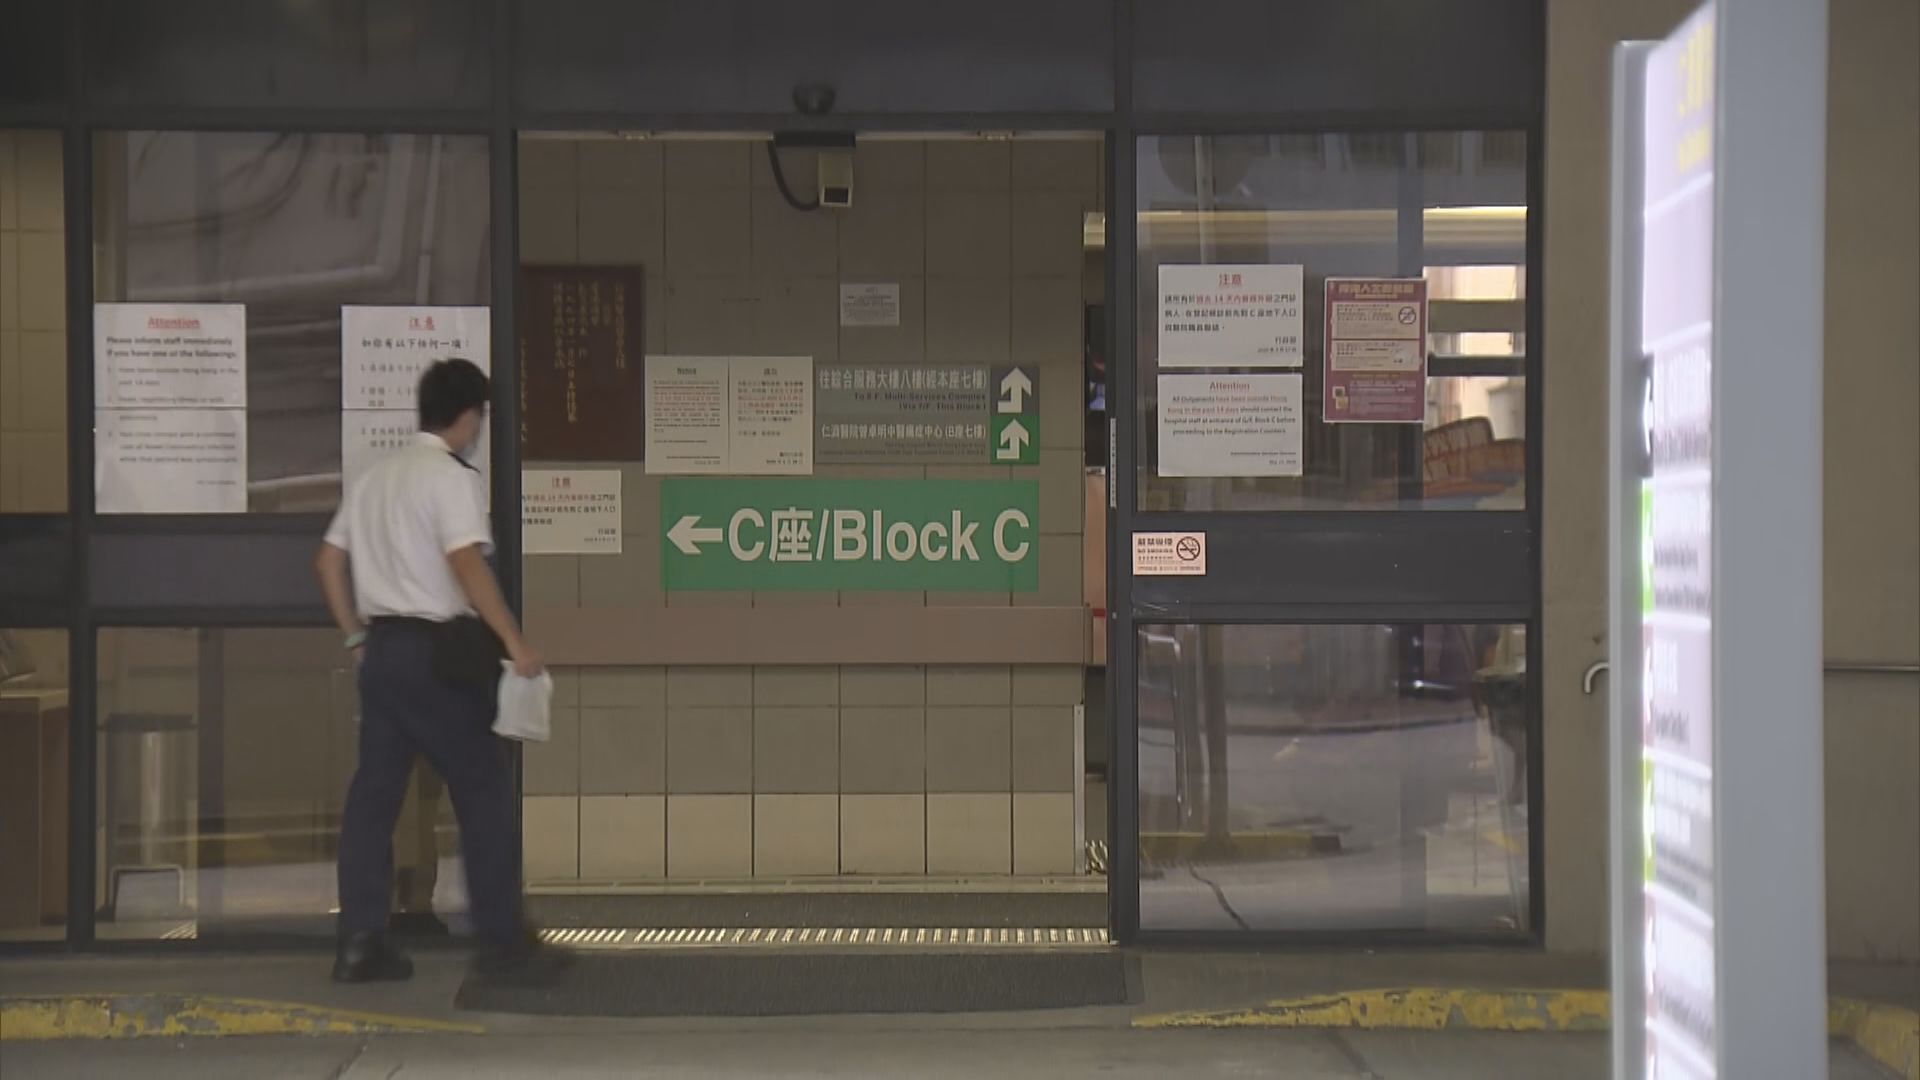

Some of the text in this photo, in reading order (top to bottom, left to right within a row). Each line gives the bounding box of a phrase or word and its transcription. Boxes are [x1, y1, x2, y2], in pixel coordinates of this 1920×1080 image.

[148, 317, 200, 329] Attention
[107, 336, 132, 346] Please
[1209, 382, 1250, 391] Attention
[728, 506, 1030, 563] C座/Block C
